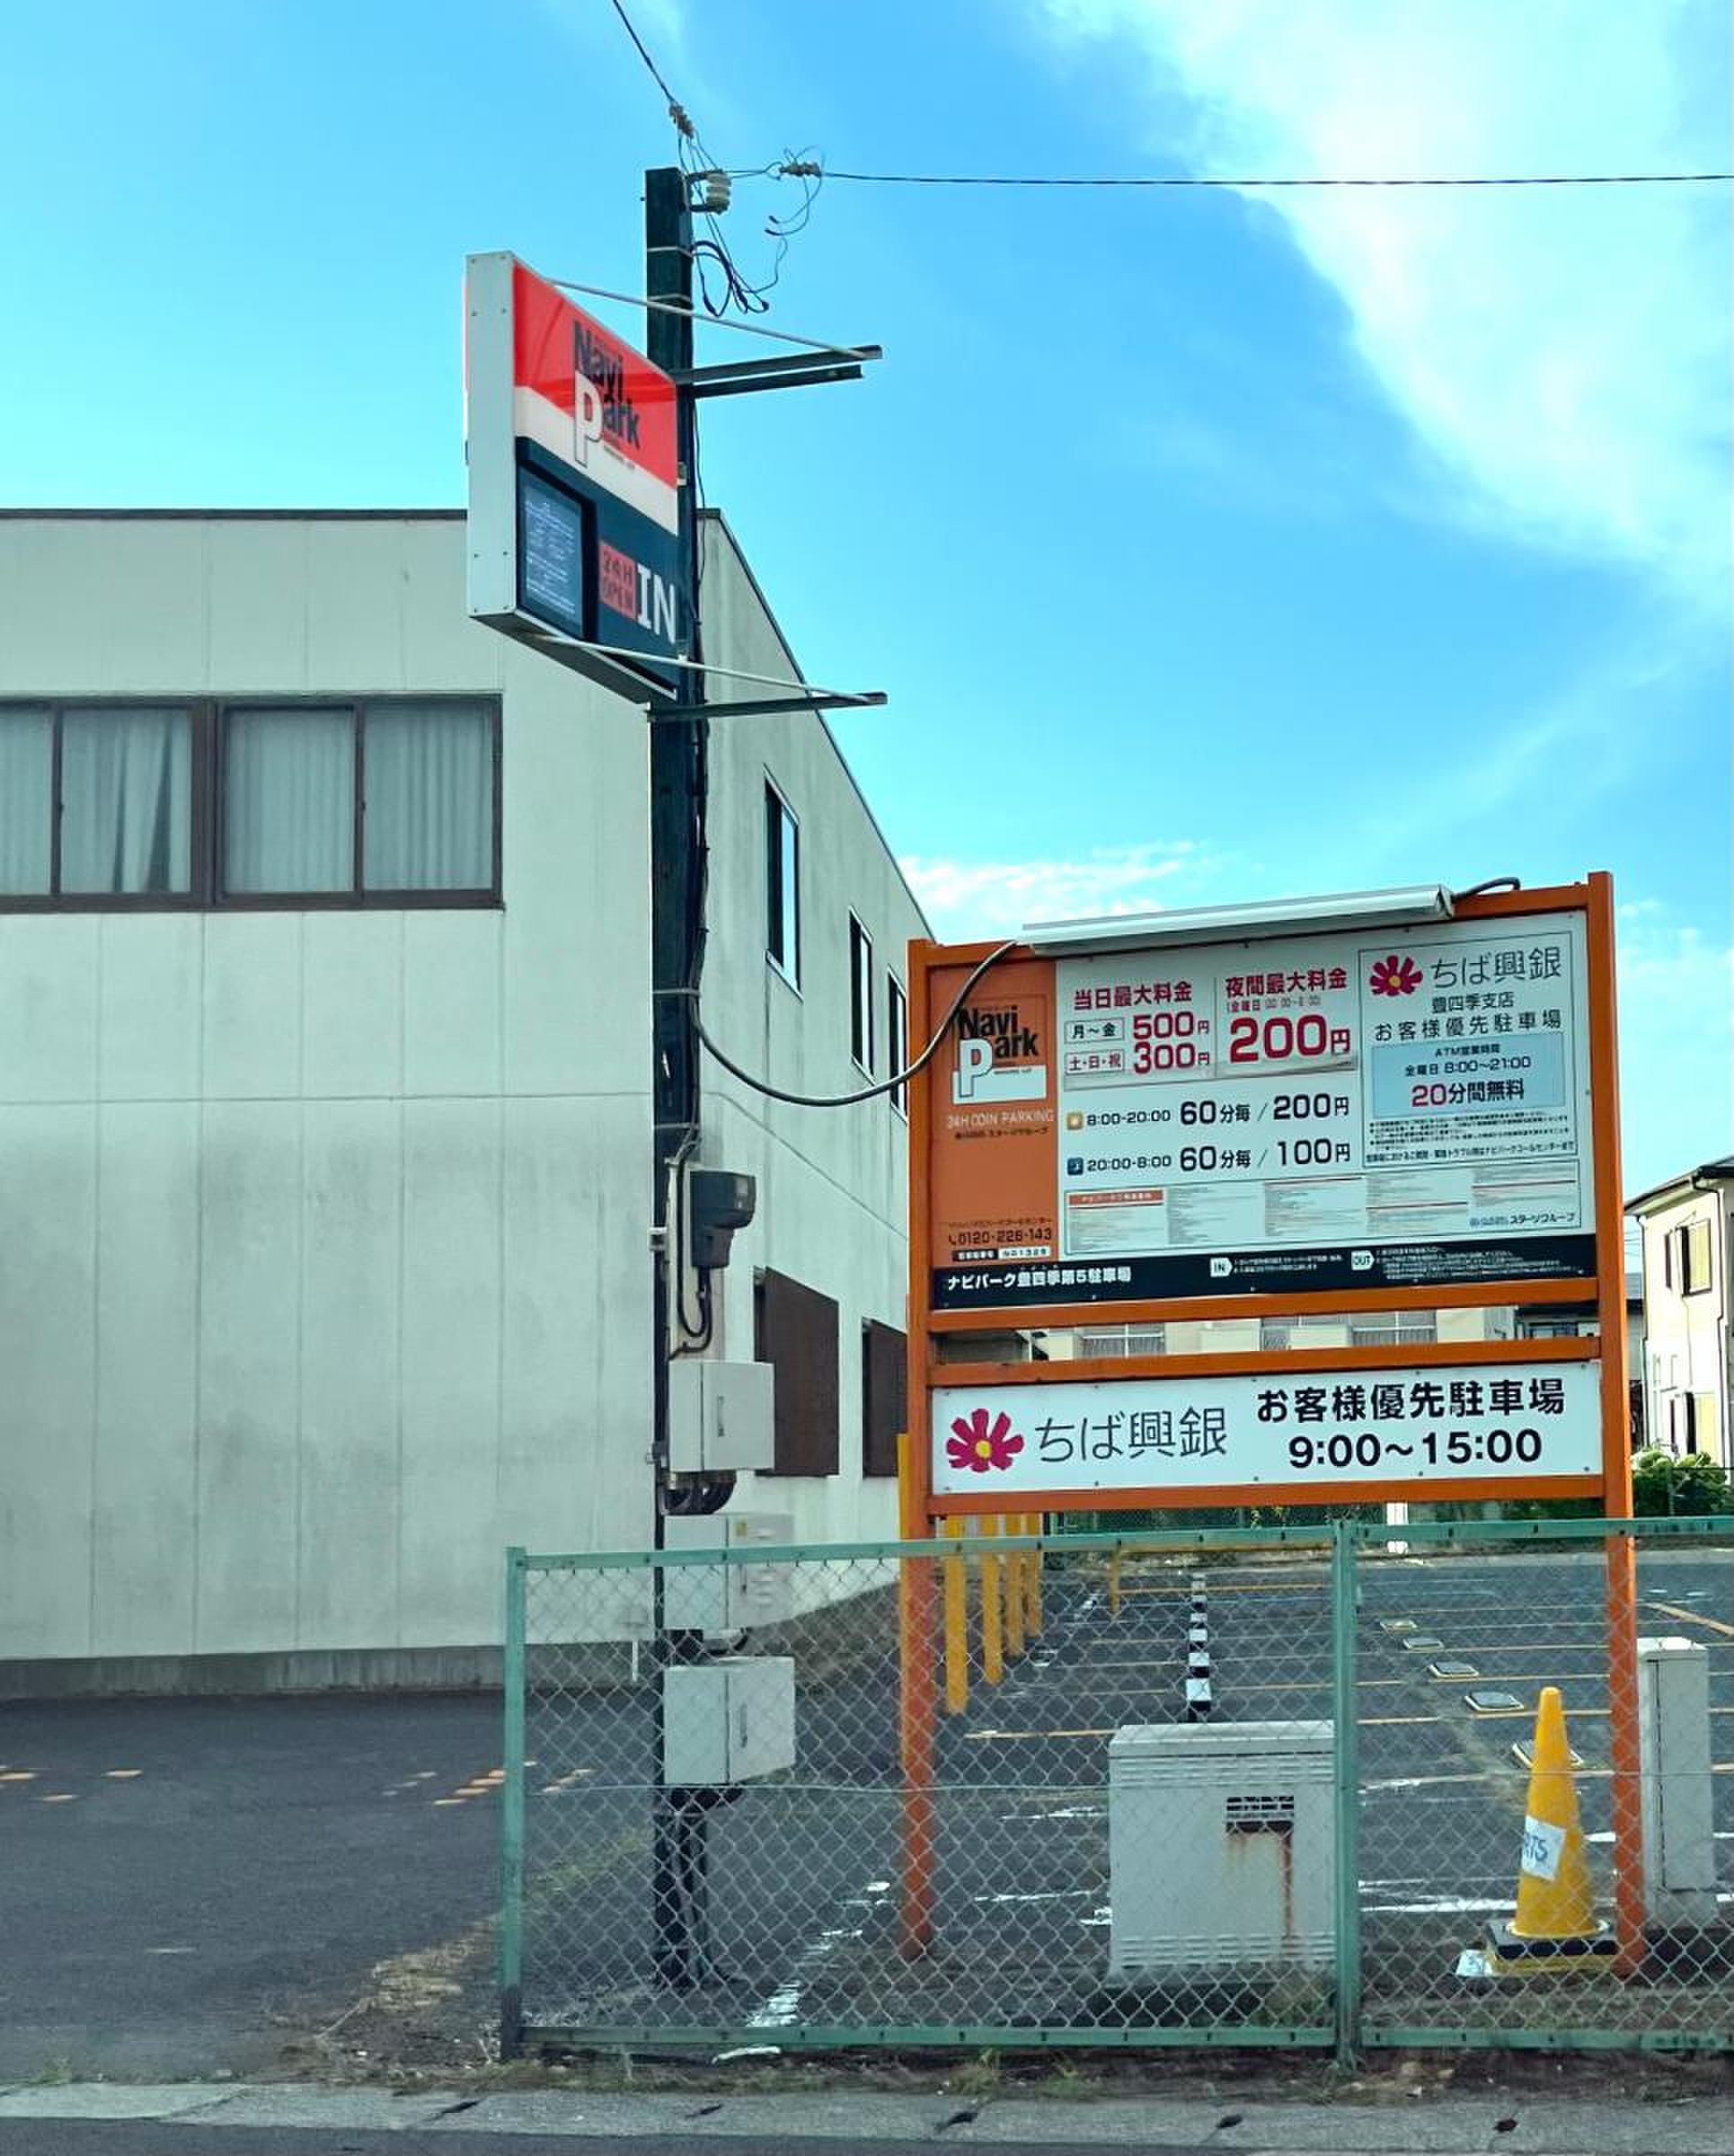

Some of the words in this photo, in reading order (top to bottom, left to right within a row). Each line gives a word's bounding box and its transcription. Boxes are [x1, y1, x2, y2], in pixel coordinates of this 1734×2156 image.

[575, 320, 624, 403] Navi
[574, 370, 641, 468] Park
[637, 563, 676, 644] IN
[1225, 968, 1347, 998] 夜間最大料金
[1430, 946, 1561, 988] ちば興銀
[1074, 981, 1192, 1011] 当日最大料金
[958, 1006, 1018, 1039] Navi
[1133, 1011, 1209, 1040] 500円
[1230, 1014, 1350, 1063] 200円
[1375, 1010, 1561, 1042] お客様優先駐車場
[958, 1028, 1039, 1098] Park
[1133, 1041, 1210, 1074] 300円
[1411, 1077, 1525, 1108] 20分間無料
[1257, 1378, 1565, 1423] お客様優先駐車場
[1035, 1405, 1227, 1462] ちば興銀
